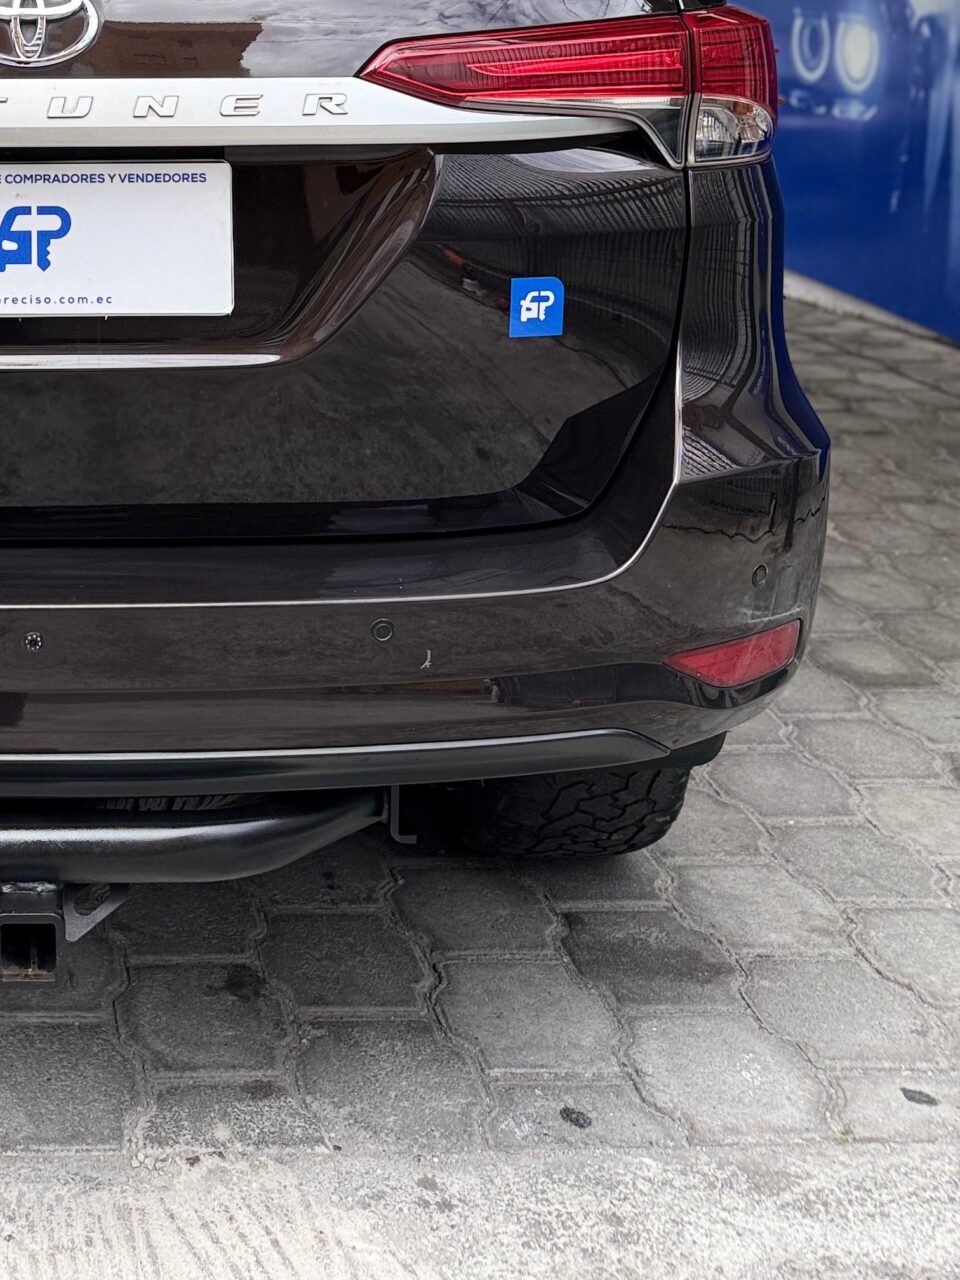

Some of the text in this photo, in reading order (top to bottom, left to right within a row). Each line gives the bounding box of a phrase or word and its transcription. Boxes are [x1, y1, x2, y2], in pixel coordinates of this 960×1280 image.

[4, 173, 105, 185] COMPRADORES
[108, 173, 116, 184] Y
[118, 172, 207, 184] VENDEDORES
